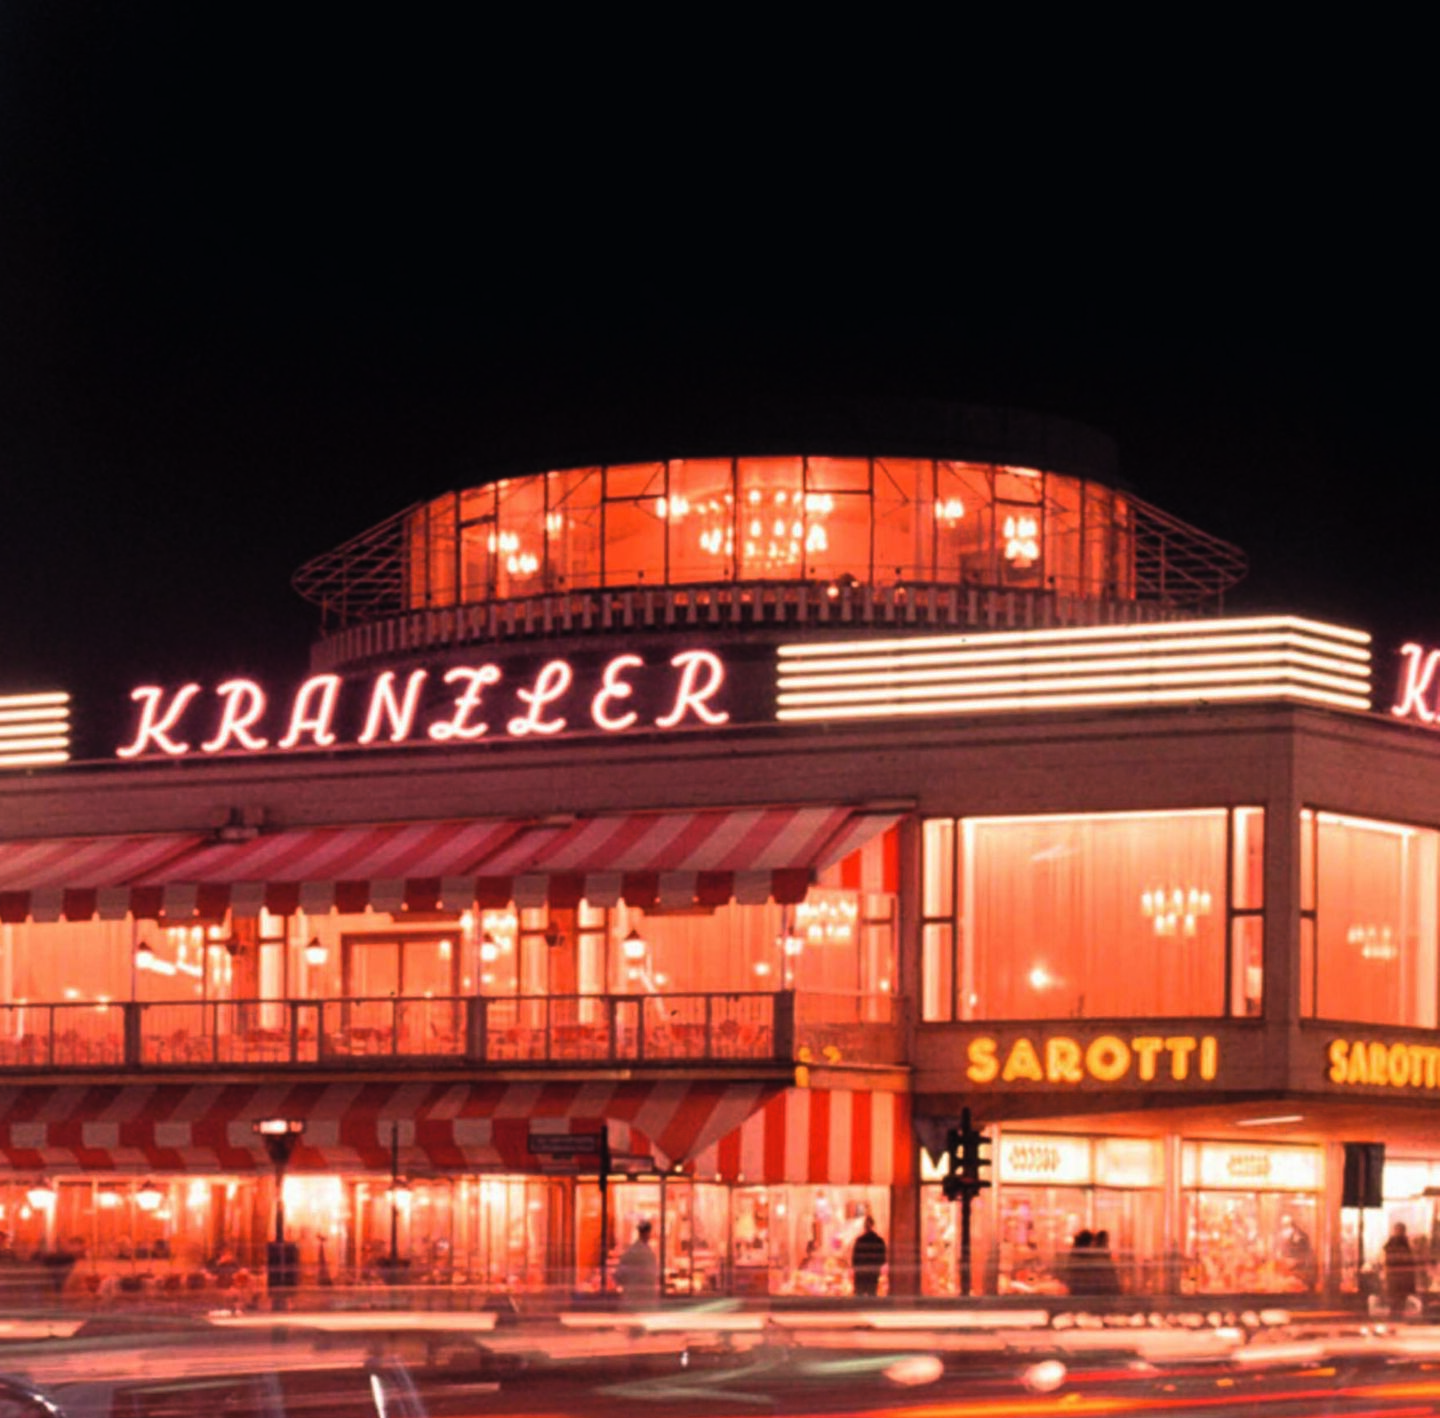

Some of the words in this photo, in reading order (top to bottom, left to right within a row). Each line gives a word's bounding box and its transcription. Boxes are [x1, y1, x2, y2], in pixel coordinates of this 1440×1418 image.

[116, 649, 730, 758] KRANZLER
[966, 1035, 1217, 1083] SAROTTI
[1329, 1038, 1440, 1089] SAROTT
